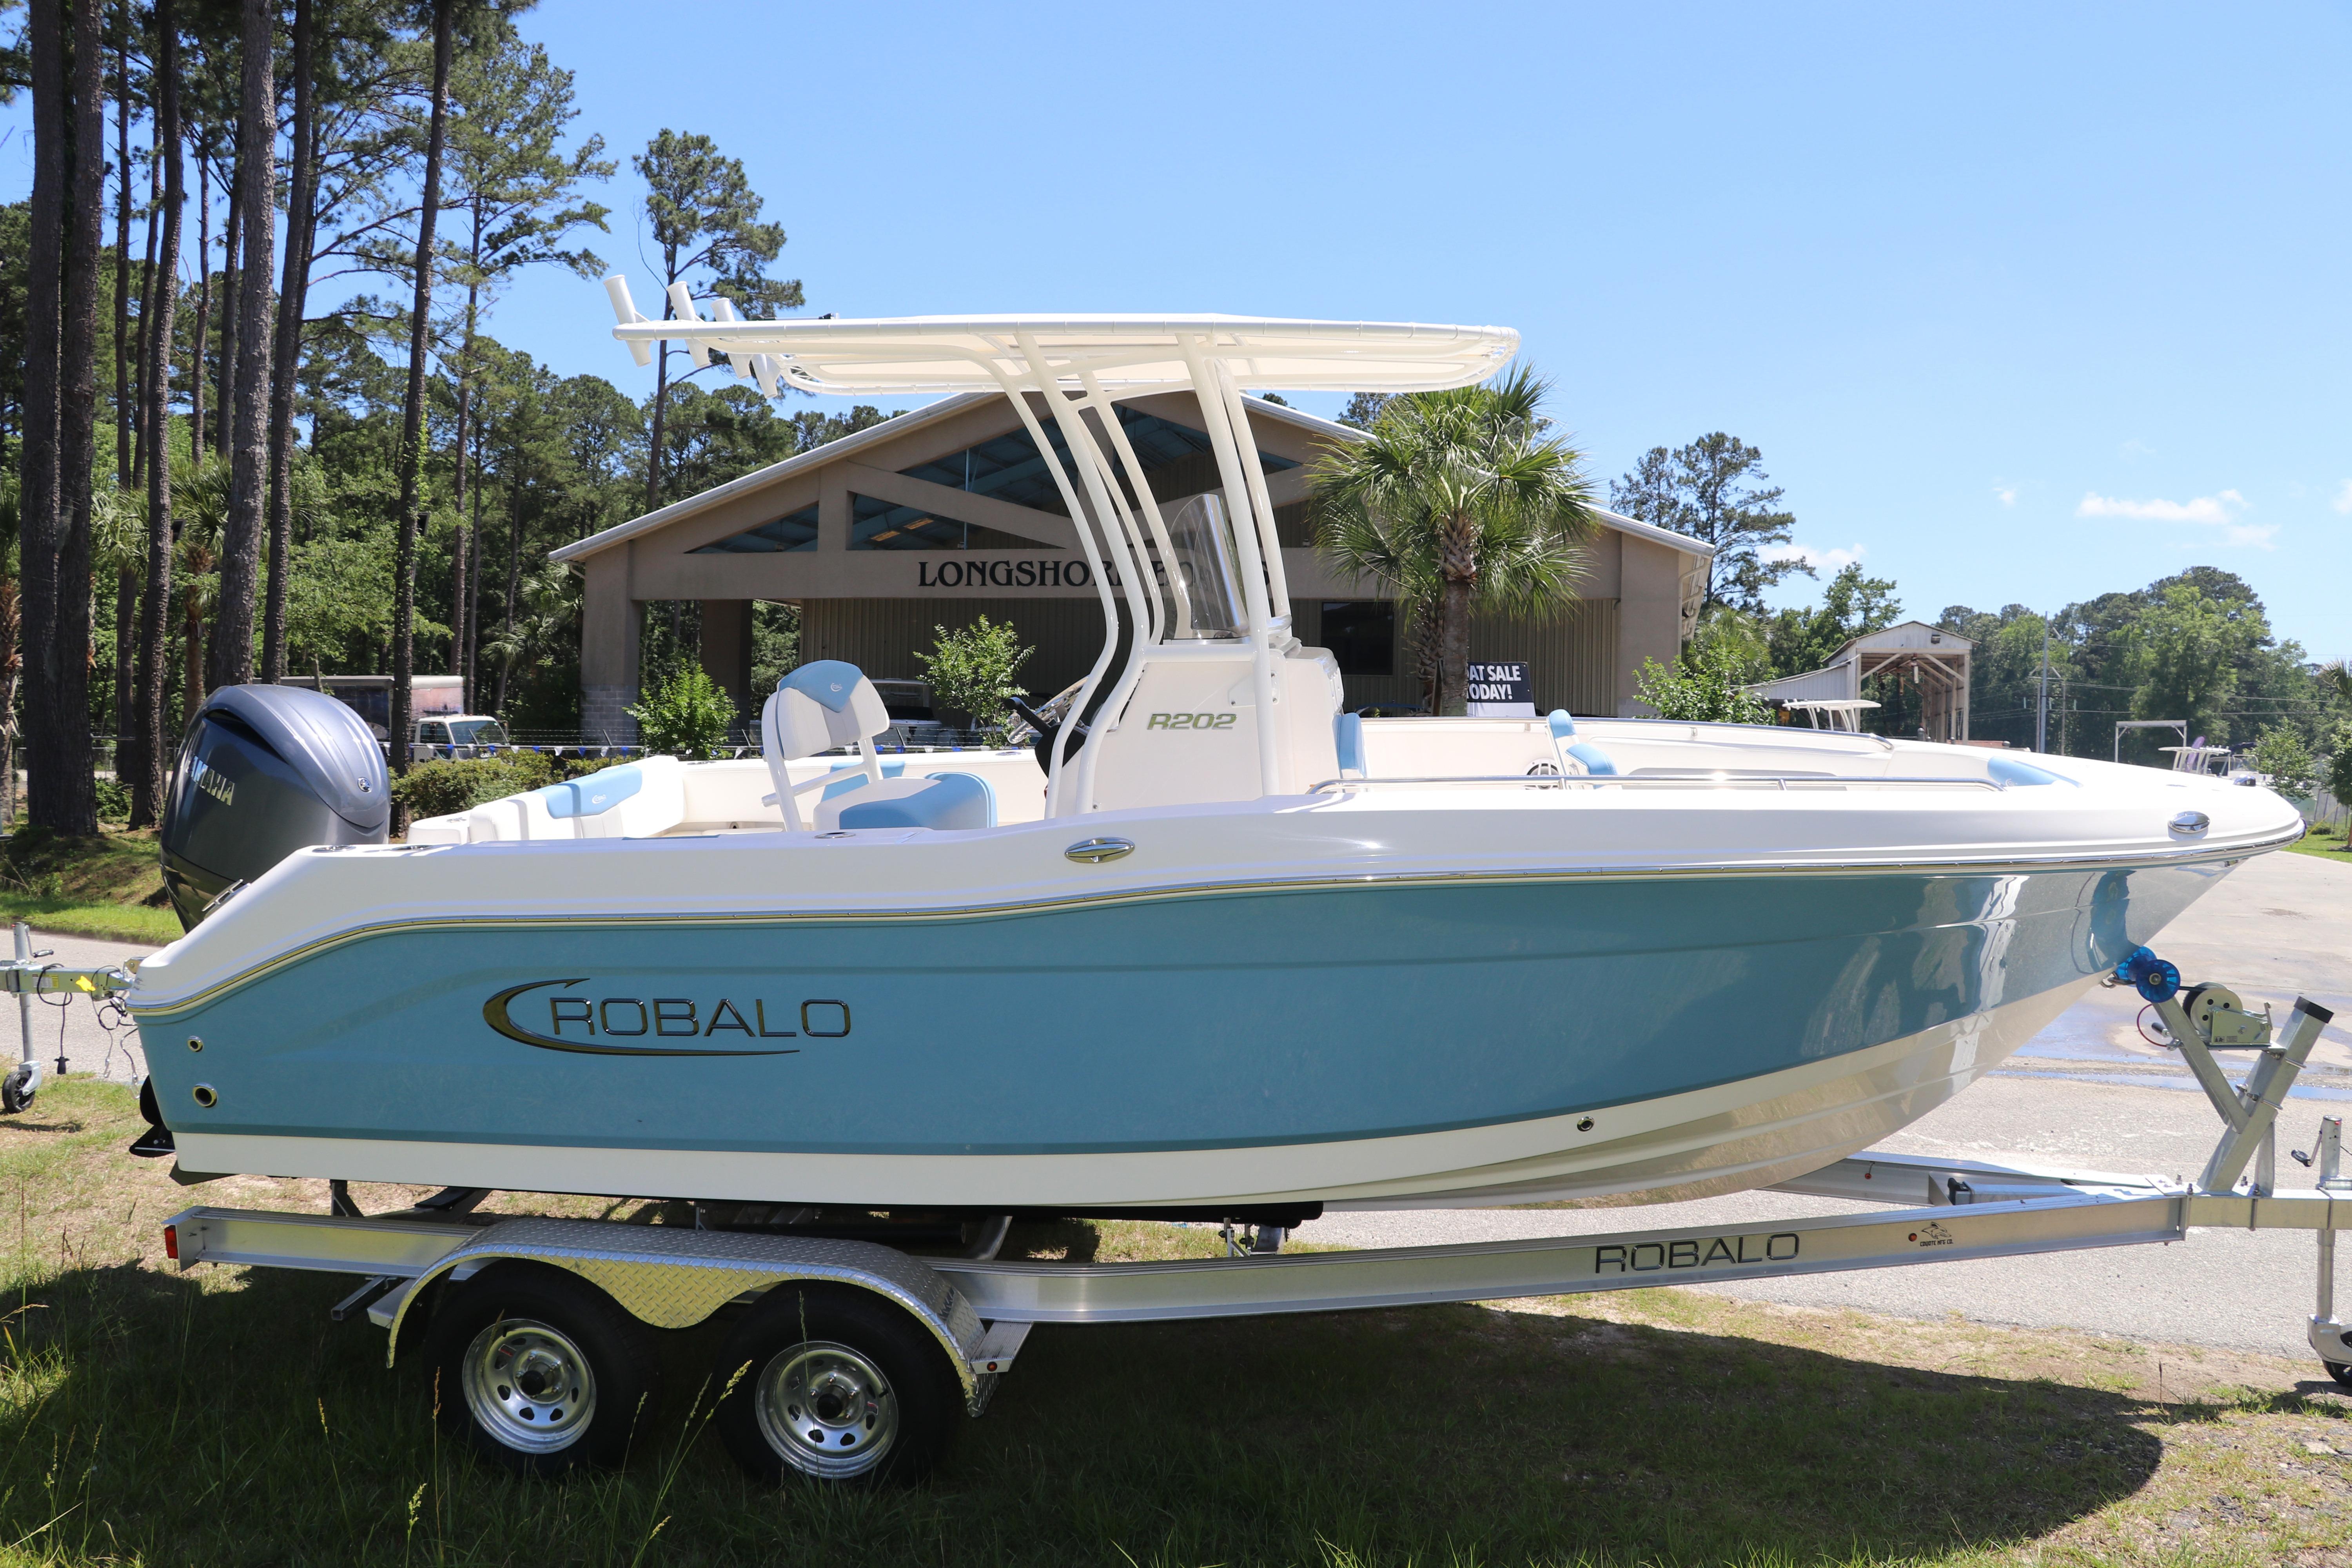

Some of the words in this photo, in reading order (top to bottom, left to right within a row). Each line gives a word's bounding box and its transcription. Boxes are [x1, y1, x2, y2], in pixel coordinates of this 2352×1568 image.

[918, 561, 1134, 586] LONGSHOR
[1467, 665, 1485, 681] AT
[1487, 665, 1521, 681] SALE
[1467, 683, 1513, 700] ODAY!
[1147, 713, 1238, 730] R202
[549, 997, 851, 1038] ROBALO
[1595, 1233, 1799, 1274] ROBALO
